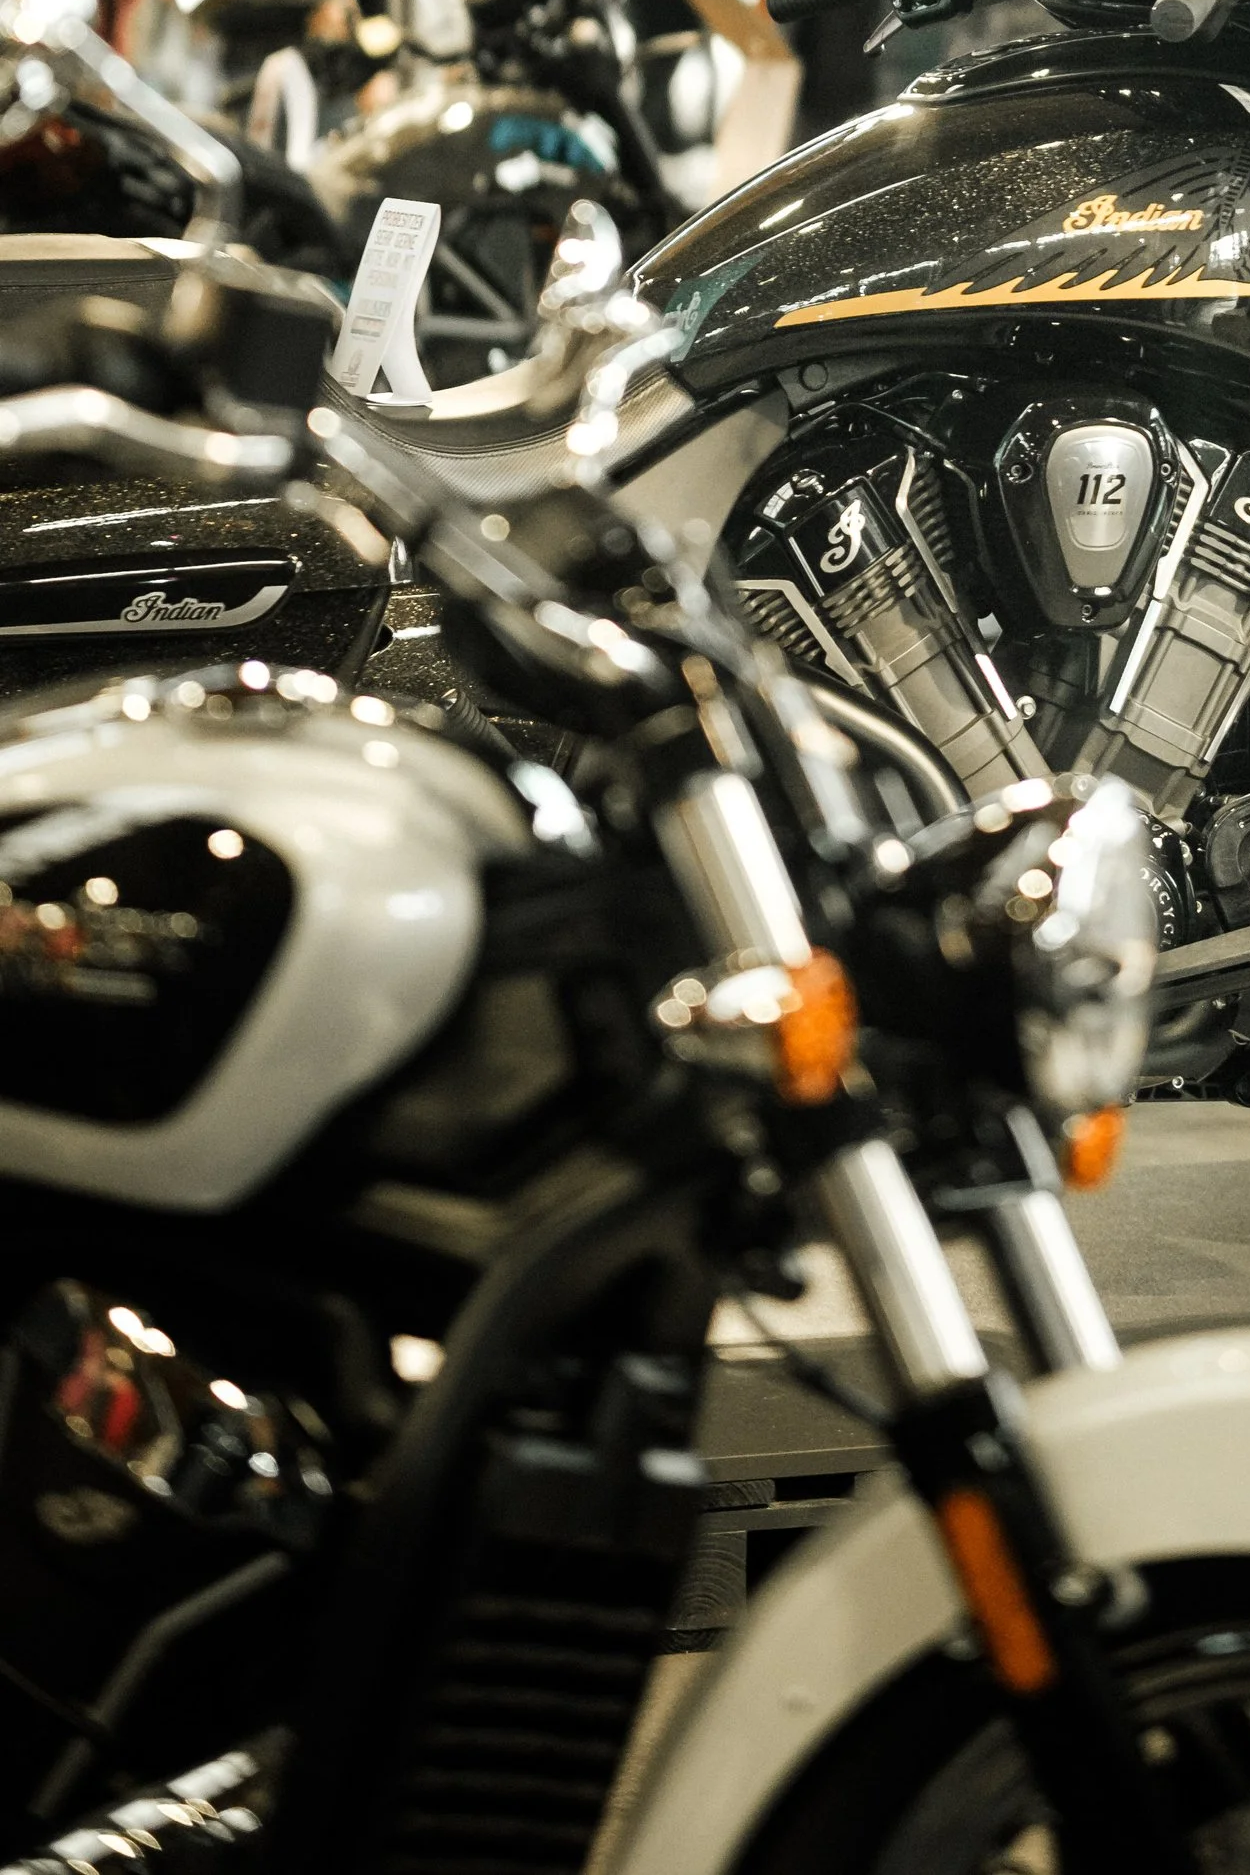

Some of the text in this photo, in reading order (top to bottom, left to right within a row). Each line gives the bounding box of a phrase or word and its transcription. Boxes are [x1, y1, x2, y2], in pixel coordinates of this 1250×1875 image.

[1063, 194, 1204, 234] Indian
[1077, 474, 1126, 504] 112
[121, 592, 224, 623] Indian
